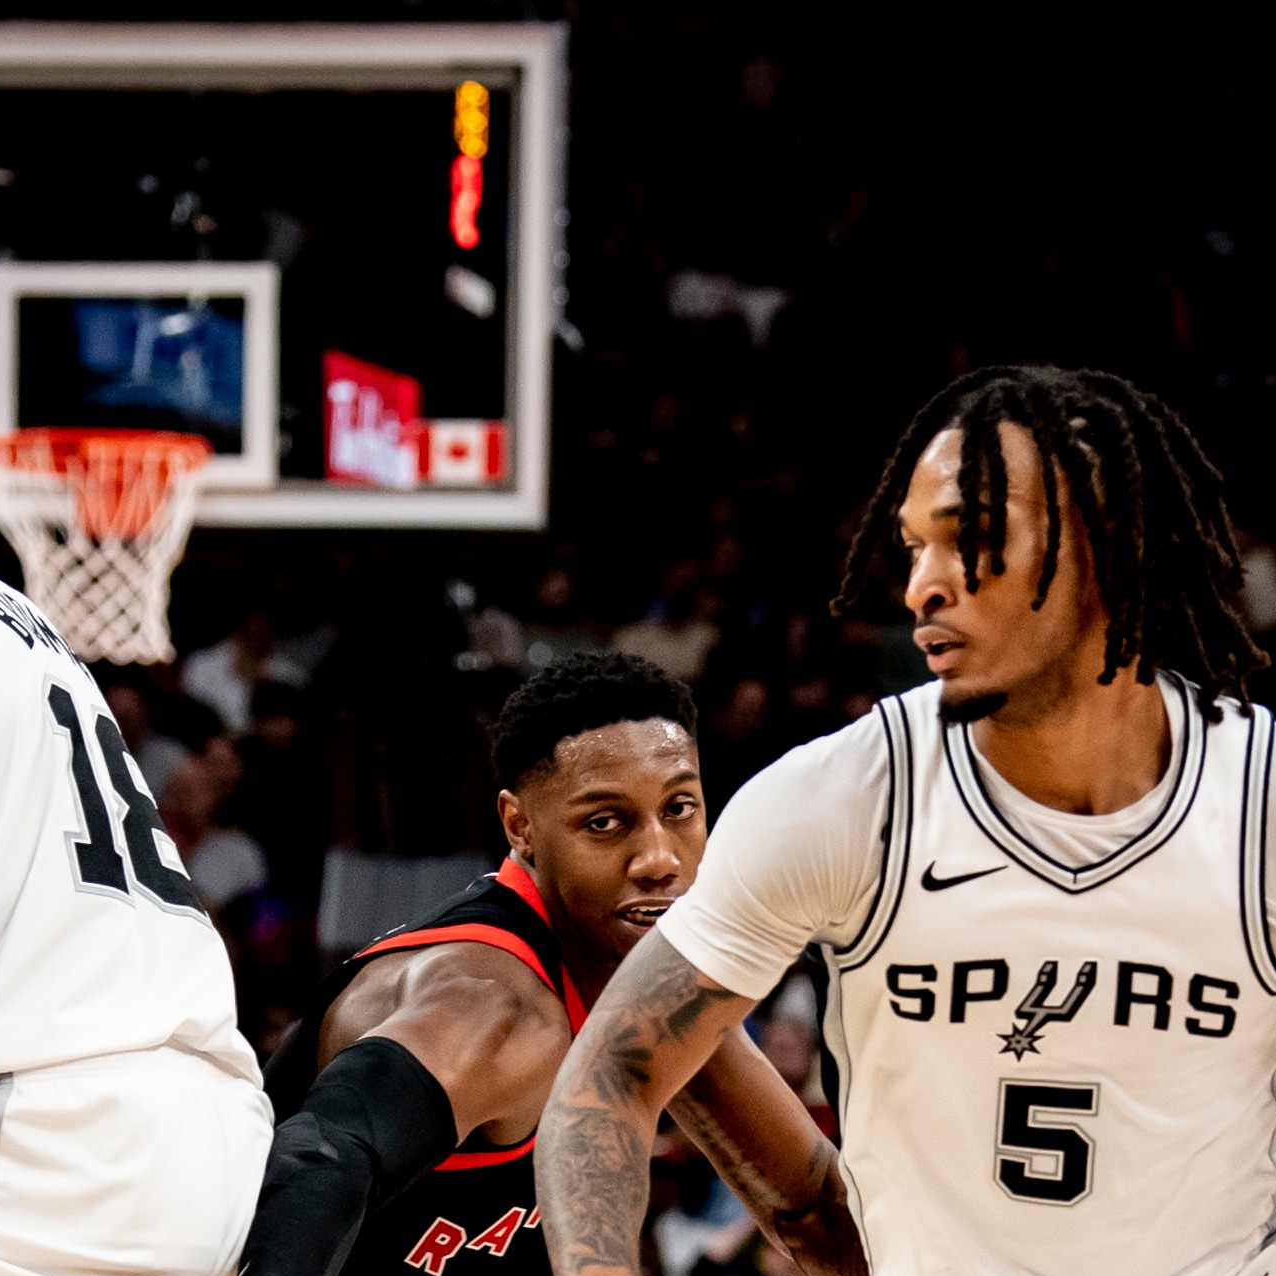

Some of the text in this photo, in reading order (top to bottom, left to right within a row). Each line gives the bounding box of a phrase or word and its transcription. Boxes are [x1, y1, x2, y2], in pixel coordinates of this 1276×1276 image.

[43, 676, 212, 928] 18
[886, 960, 1241, 1062] SPURS
[994, 1078, 1101, 1208] 5
